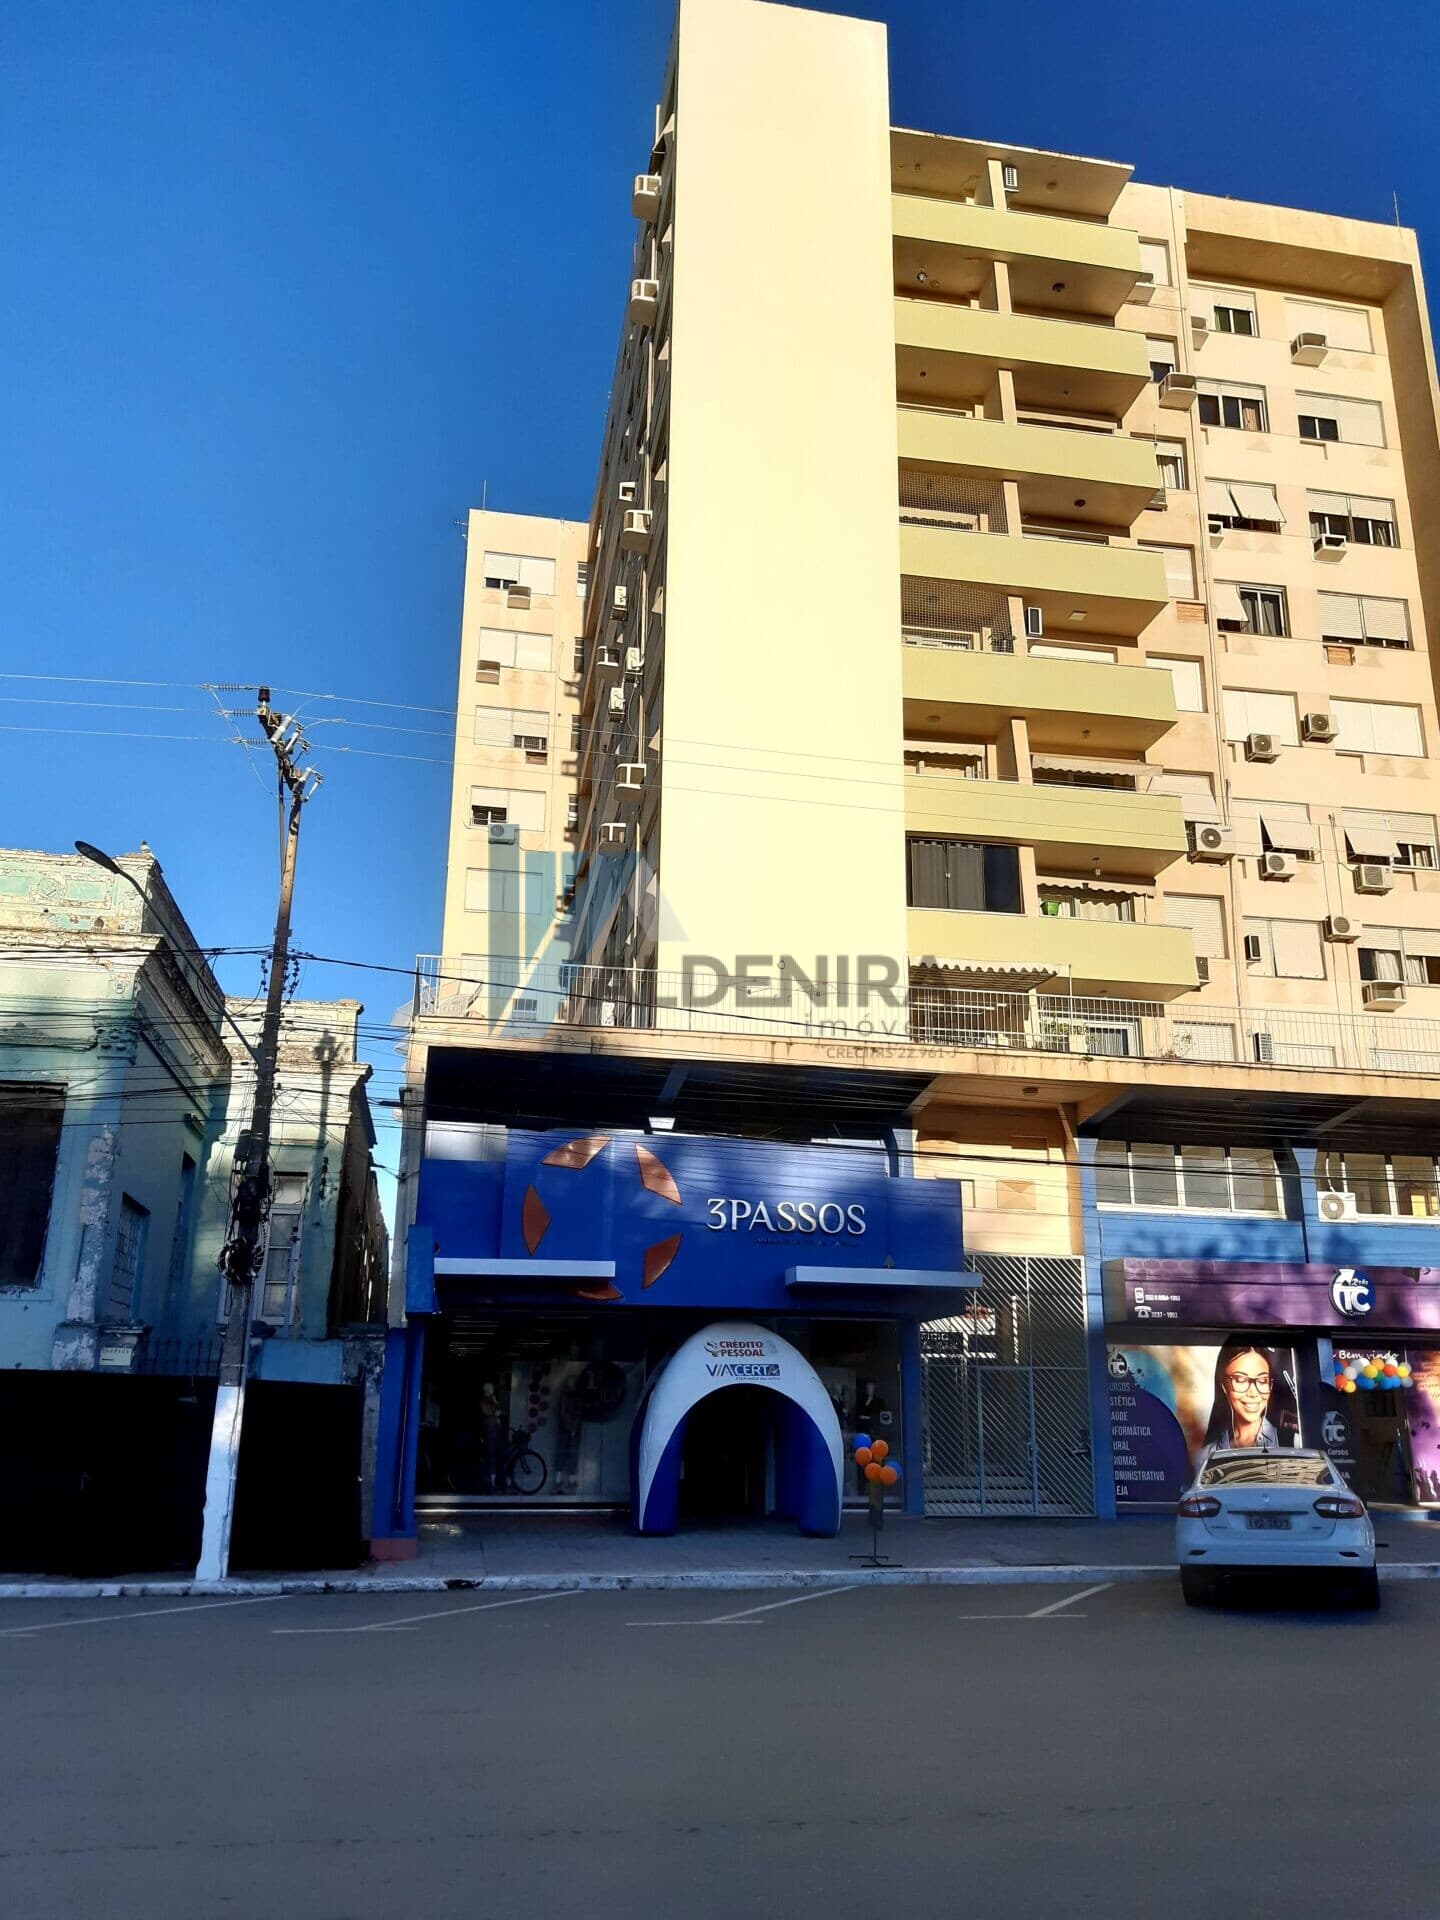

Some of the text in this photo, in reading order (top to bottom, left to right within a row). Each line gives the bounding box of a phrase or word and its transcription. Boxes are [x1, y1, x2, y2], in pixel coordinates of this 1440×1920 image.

[706, 1198, 867, 1235] 3PASSOS
[720, 1349, 766, 1357] PESSOAL
[1338, 1350, 1362, 1360] Bem
[1109, 1396, 1137, 1407] STÉTICA
[1110, 1411, 1128, 1421] AUDE
[1112, 1425, 1151, 1436] FORMÁTICA
[1114, 1471, 1165, 1481] DMINISTRATIVO
